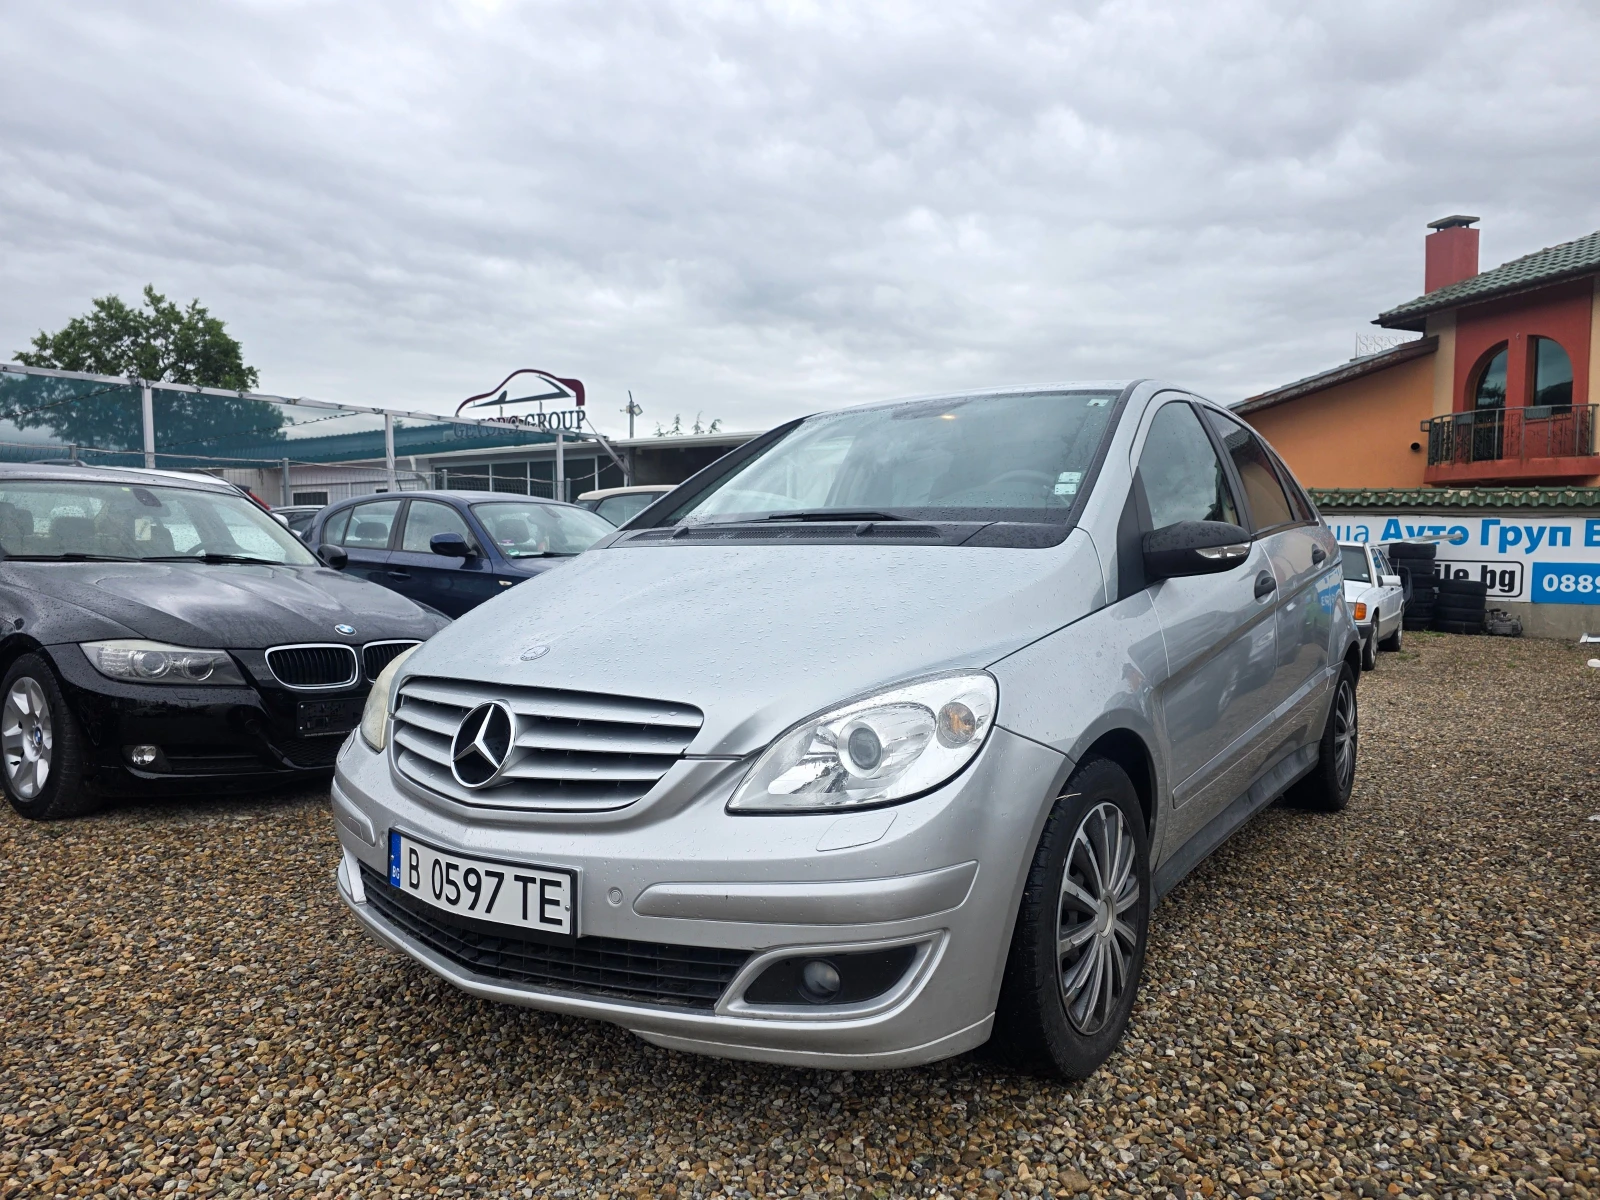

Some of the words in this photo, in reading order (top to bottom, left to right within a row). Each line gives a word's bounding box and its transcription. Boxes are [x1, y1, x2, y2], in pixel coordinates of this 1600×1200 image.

[525, 410, 586, 431] GROUP
[1480, 519, 1571, 555] Груп
[392, 865, 400, 880] BG
[409, 846, 421, 890] B
[431, 858, 505, 914] 0597
[513, 874, 563, 927] TE
